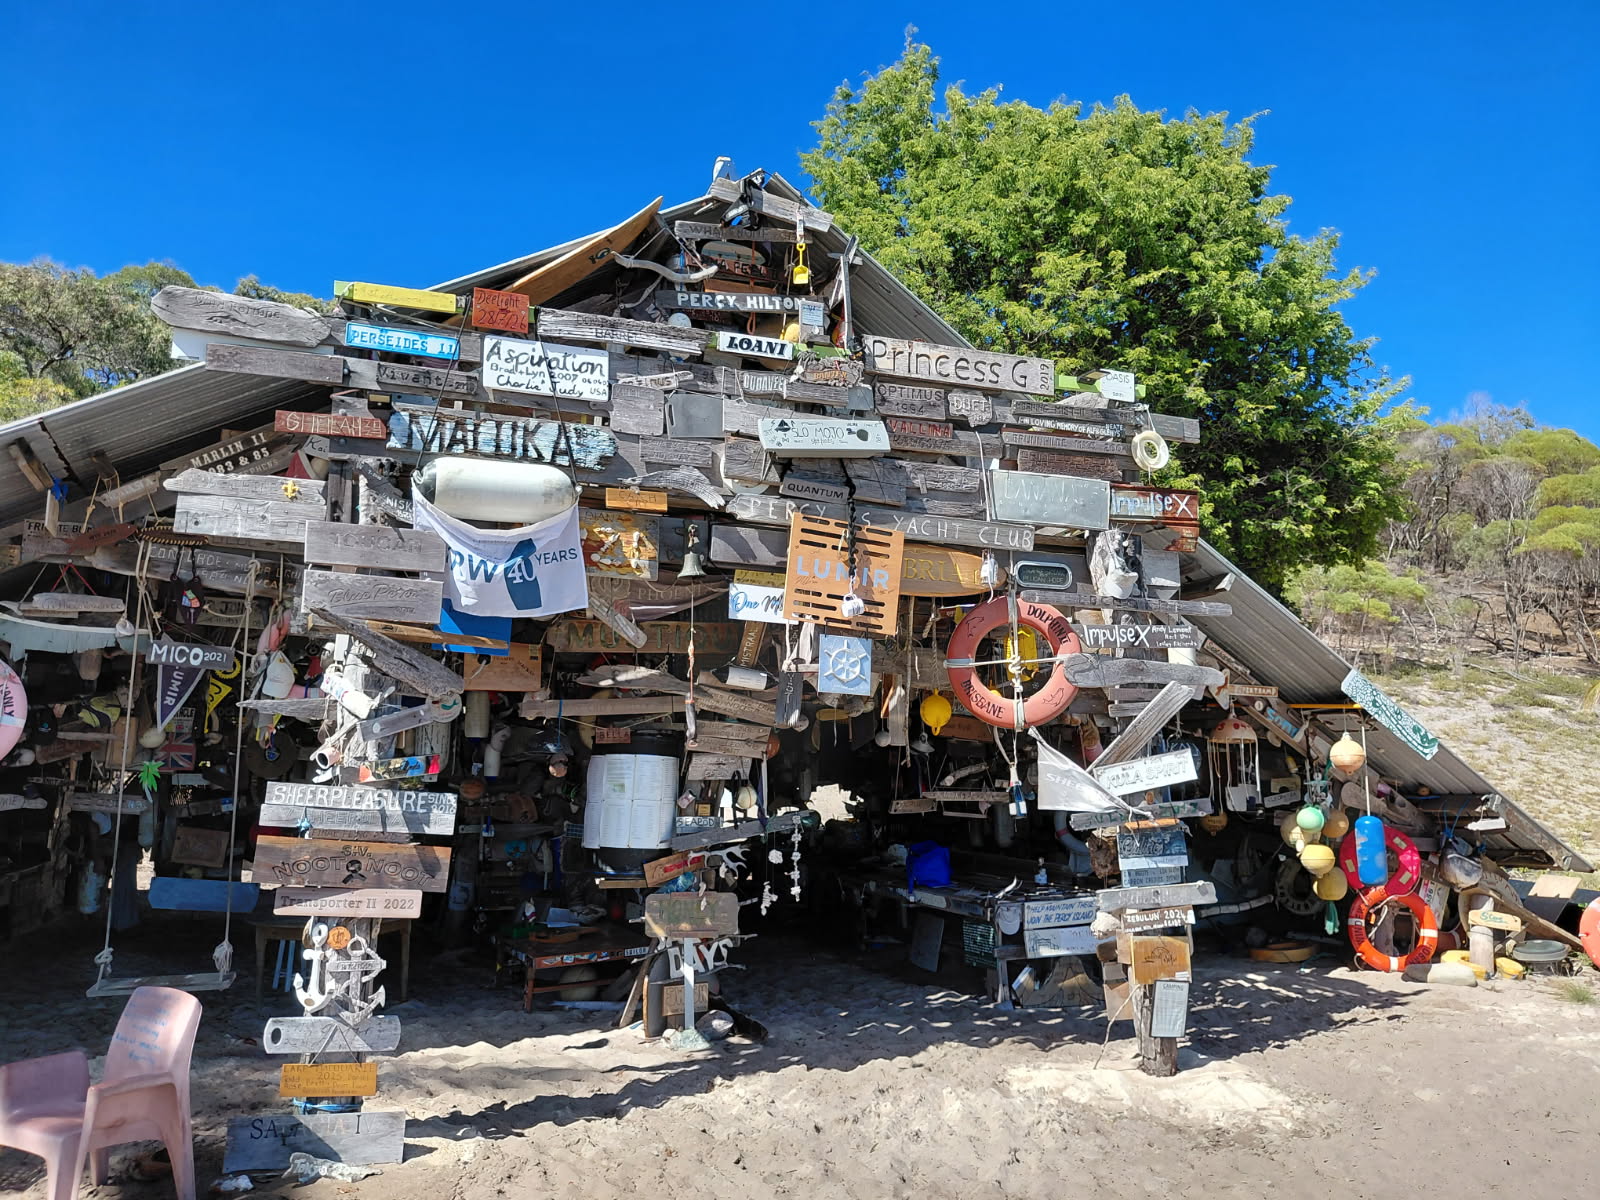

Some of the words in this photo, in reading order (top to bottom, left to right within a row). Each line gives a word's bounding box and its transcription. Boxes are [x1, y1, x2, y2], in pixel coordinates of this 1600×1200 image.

[677, 292, 736, 309] PERCY
[746, 294, 806, 311] HILTON
[351, 329, 428, 352] PERSEIDES
[726, 336, 786, 357] LOANI
[486, 341, 606, 377] Aspiration
[872, 339, 1002, 384] Princess
[1011, 359, 1028, 388] G
[1039, 363, 1050, 391] 2019
[878, 384, 943, 402] OPTIMUS
[190, 440, 244, 469] MARLIN
[253, 447, 270, 460] 85
[787, 482, 844, 501] QUANTUM
[27, 521, 70, 533] FRITE
[750, 497, 826, 521] PERCY
[893, 514, 962, 539] YACHT
[978, 526, 1033, 548] CLUB
[535, 547, 578, 566] YEARS
[734, 591, 760, 613] One
[150, 643, 204, 666] MICO
[204, 651, 227, 663] 2021
[163, 667, 185, 706] UMIR
[3, 686, 15, 718] ANLY
[960, 679, 1005, 720] BRISBANE
[272, 856, 346, 880] NOOT
[366, 857, 436, 887] NOOT
[280, 895, 362, 911] Transporter
[366, 897, 377, 909] II
[384, 898, 415, 910] 2022
